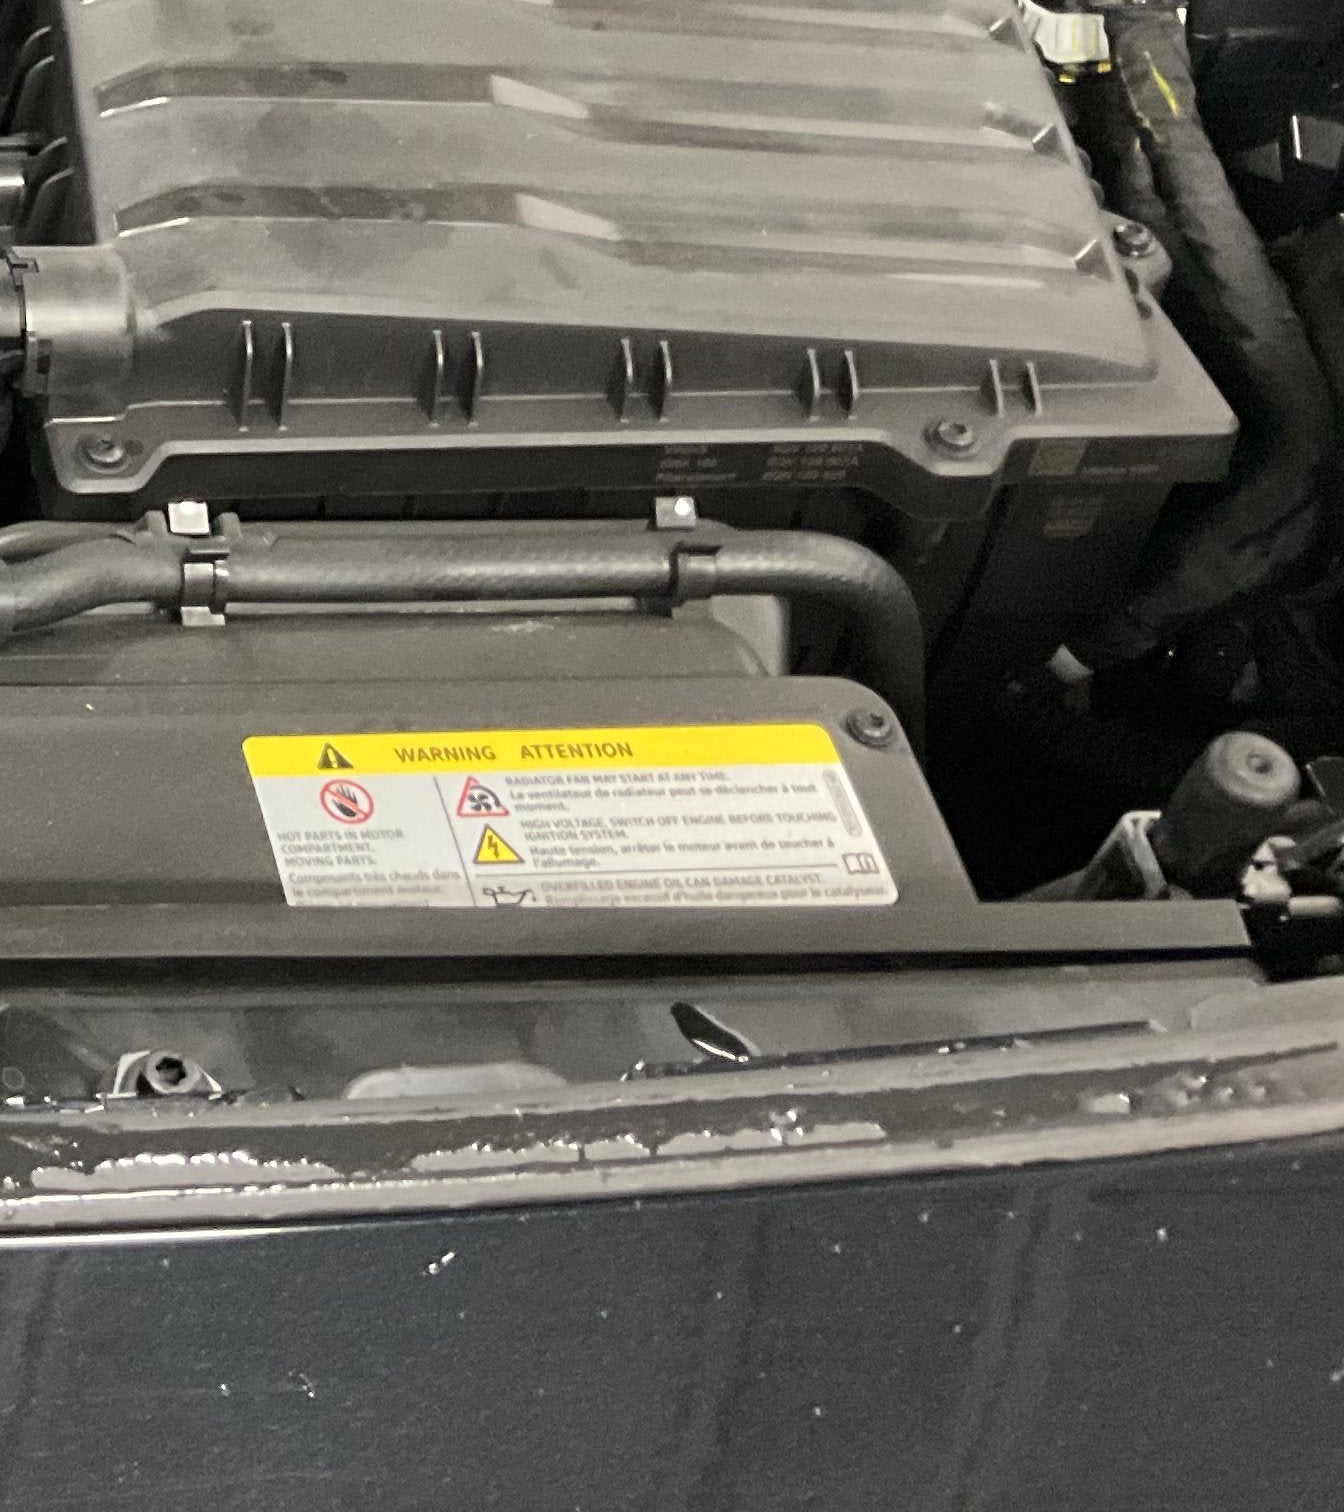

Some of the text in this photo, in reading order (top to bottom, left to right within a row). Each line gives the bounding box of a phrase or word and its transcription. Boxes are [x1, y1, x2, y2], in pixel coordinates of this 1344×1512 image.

[394, 741, 633, 763] WARNING ATTENTION
[505, 775, 563, 785] RADIATOR
[566, 775, 590, 784] FAN
[593, 774, 616, 784] MAY
[619, 773, 654, 783] START
[657, 773, 670, 782] AT
[674, 772, 696, 781] ANY
[511, 790, 524, 800] Le
[527, 789, 591, 800] ventilateur
[594, 789, 610, 798] de
[613, 787, 665, 797] radiateur
[669, 786, 696, 797] peut
[791, 784, 817, 793] tout
[520, 820, 550, 829] HIGH
[610, 817, 654, 827] SWITCH
[657, 816, 678, 826] OFF
[682, 814, 725, 825] ENGINE
[728, 813, 773, 824] BEFORE
[776, 812, 837, 823] TOUCHING
[277, 829, 403, 841] HOT PARTS IN MOTOR
[525, 831, 578, 841] IGNITION
[530, 846, 566, 856] Haute
[284, 855, 333, 867] MOVING
[432, 869, 460, 880] dans
